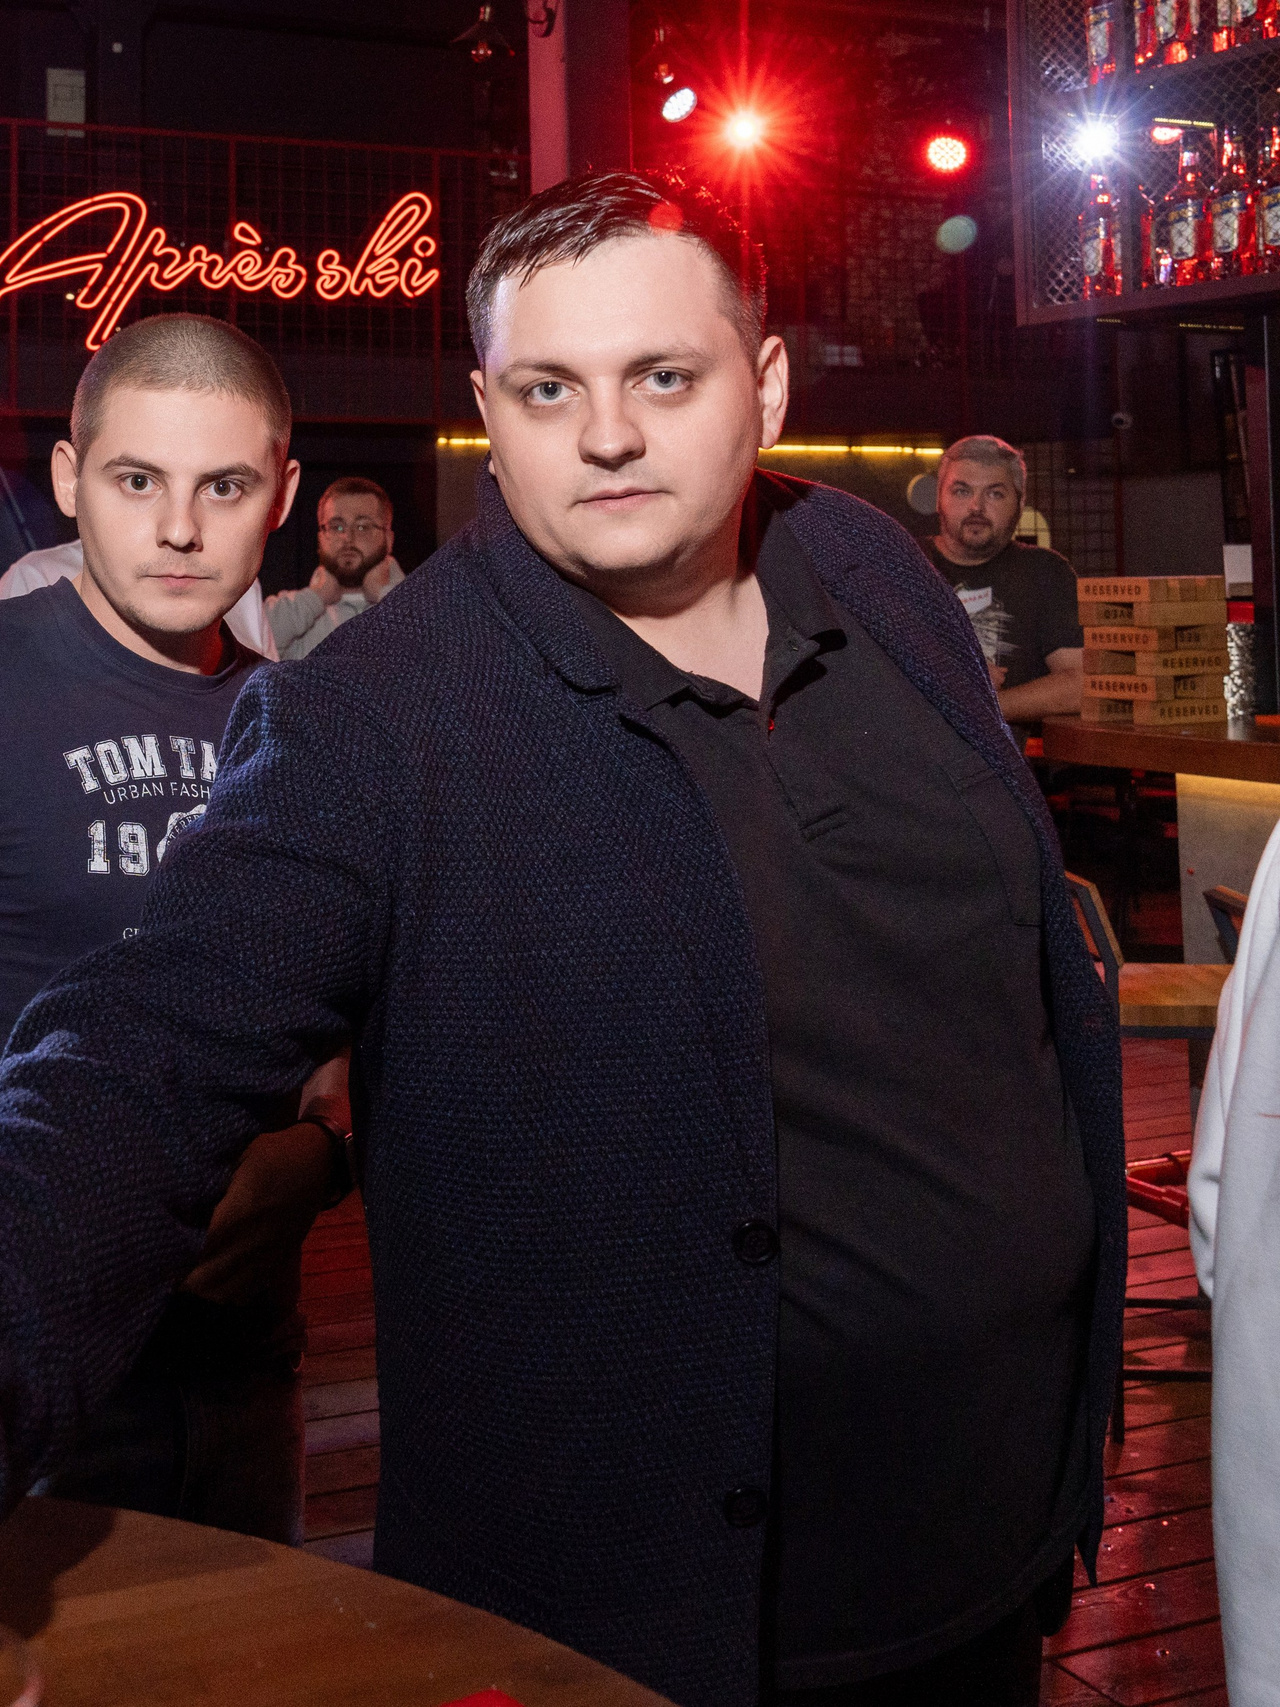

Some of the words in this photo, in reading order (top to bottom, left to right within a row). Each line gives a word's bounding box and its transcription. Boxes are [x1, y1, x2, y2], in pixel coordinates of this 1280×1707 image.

[316, 191, 439, 300] ski
[1084, 584, 1141, 596] RESERVED
[1091, 631, 1150, 644] RESERVED
[1162, 656, 1221, 668] RESERVED
[1091, 680, 1148, 692] RESERVED
[1160, 706, 1219, 718] RESERVED
[62, 733, 168, 794] TOM
[103, 782, 165, 805] URBAN
[170, 781, 211, 799] FASH
[87, 819, 150, 877] 19
